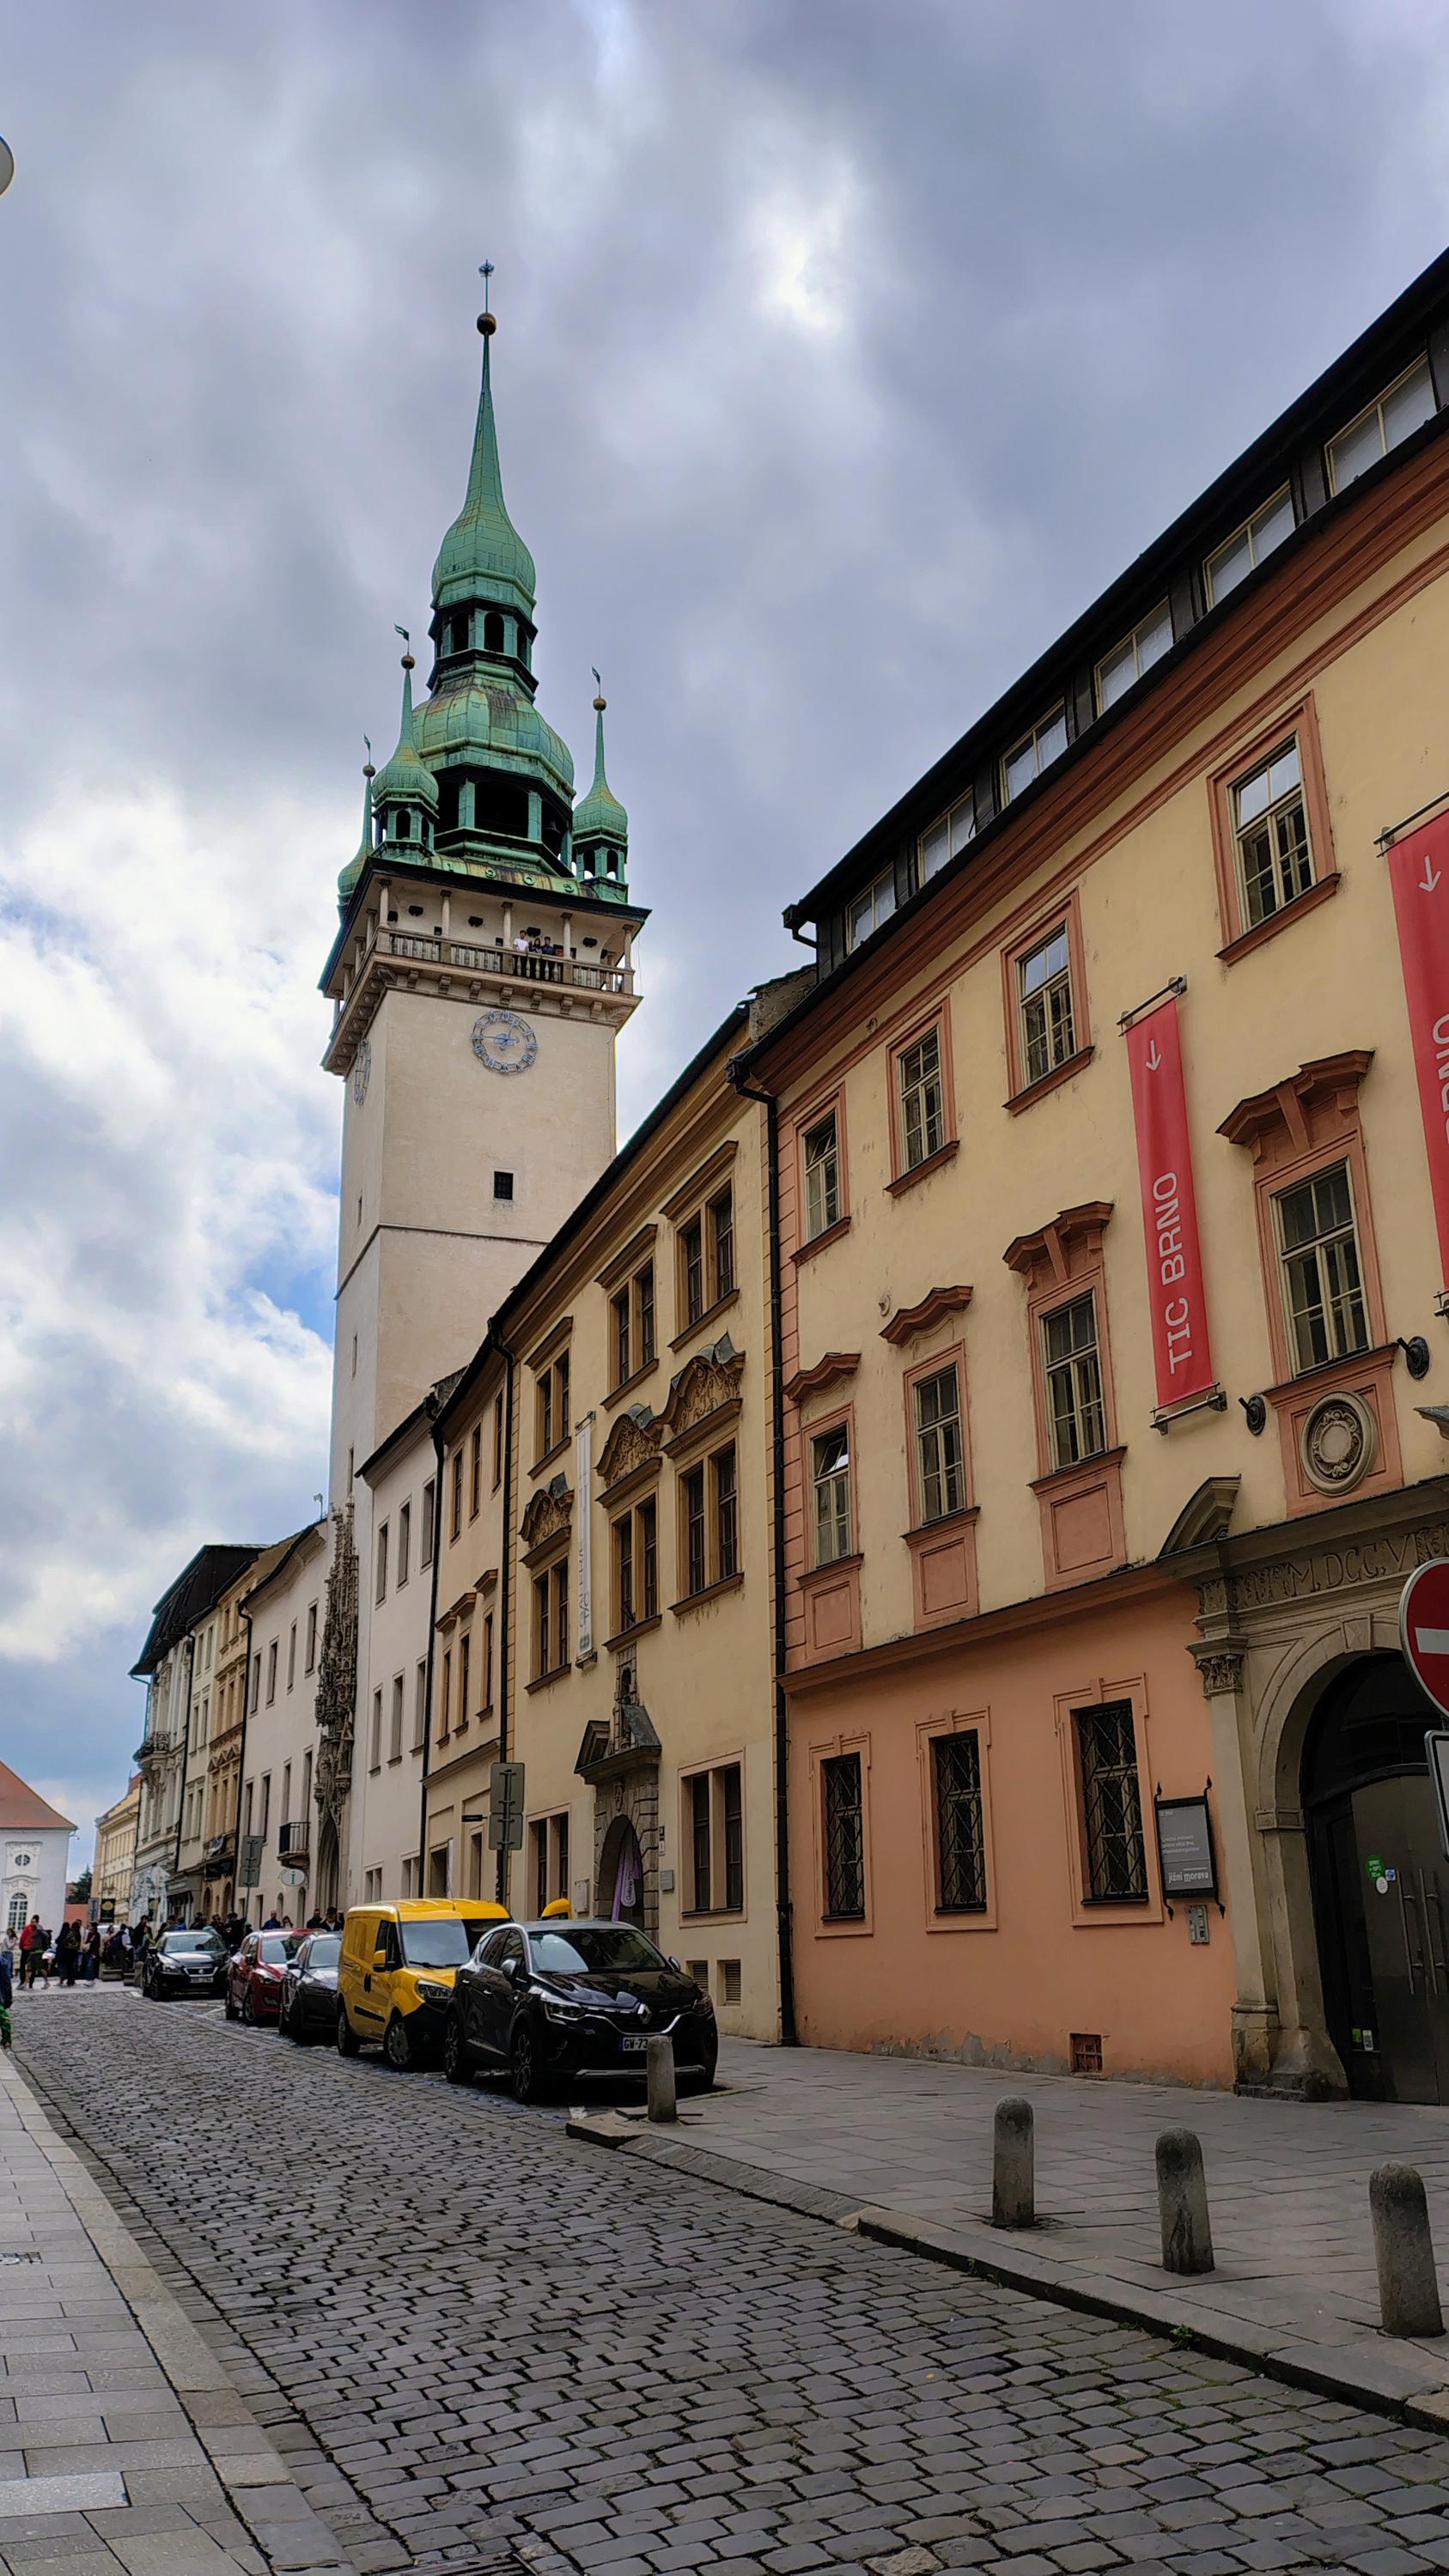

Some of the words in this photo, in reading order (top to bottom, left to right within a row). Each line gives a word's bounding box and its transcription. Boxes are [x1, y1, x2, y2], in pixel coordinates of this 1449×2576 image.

[1153, 1171, 1186, 1286] BRNO
[1165, 1297, 1193, 1376] TIC
[624, 2038, 648, 2050] GW-73
